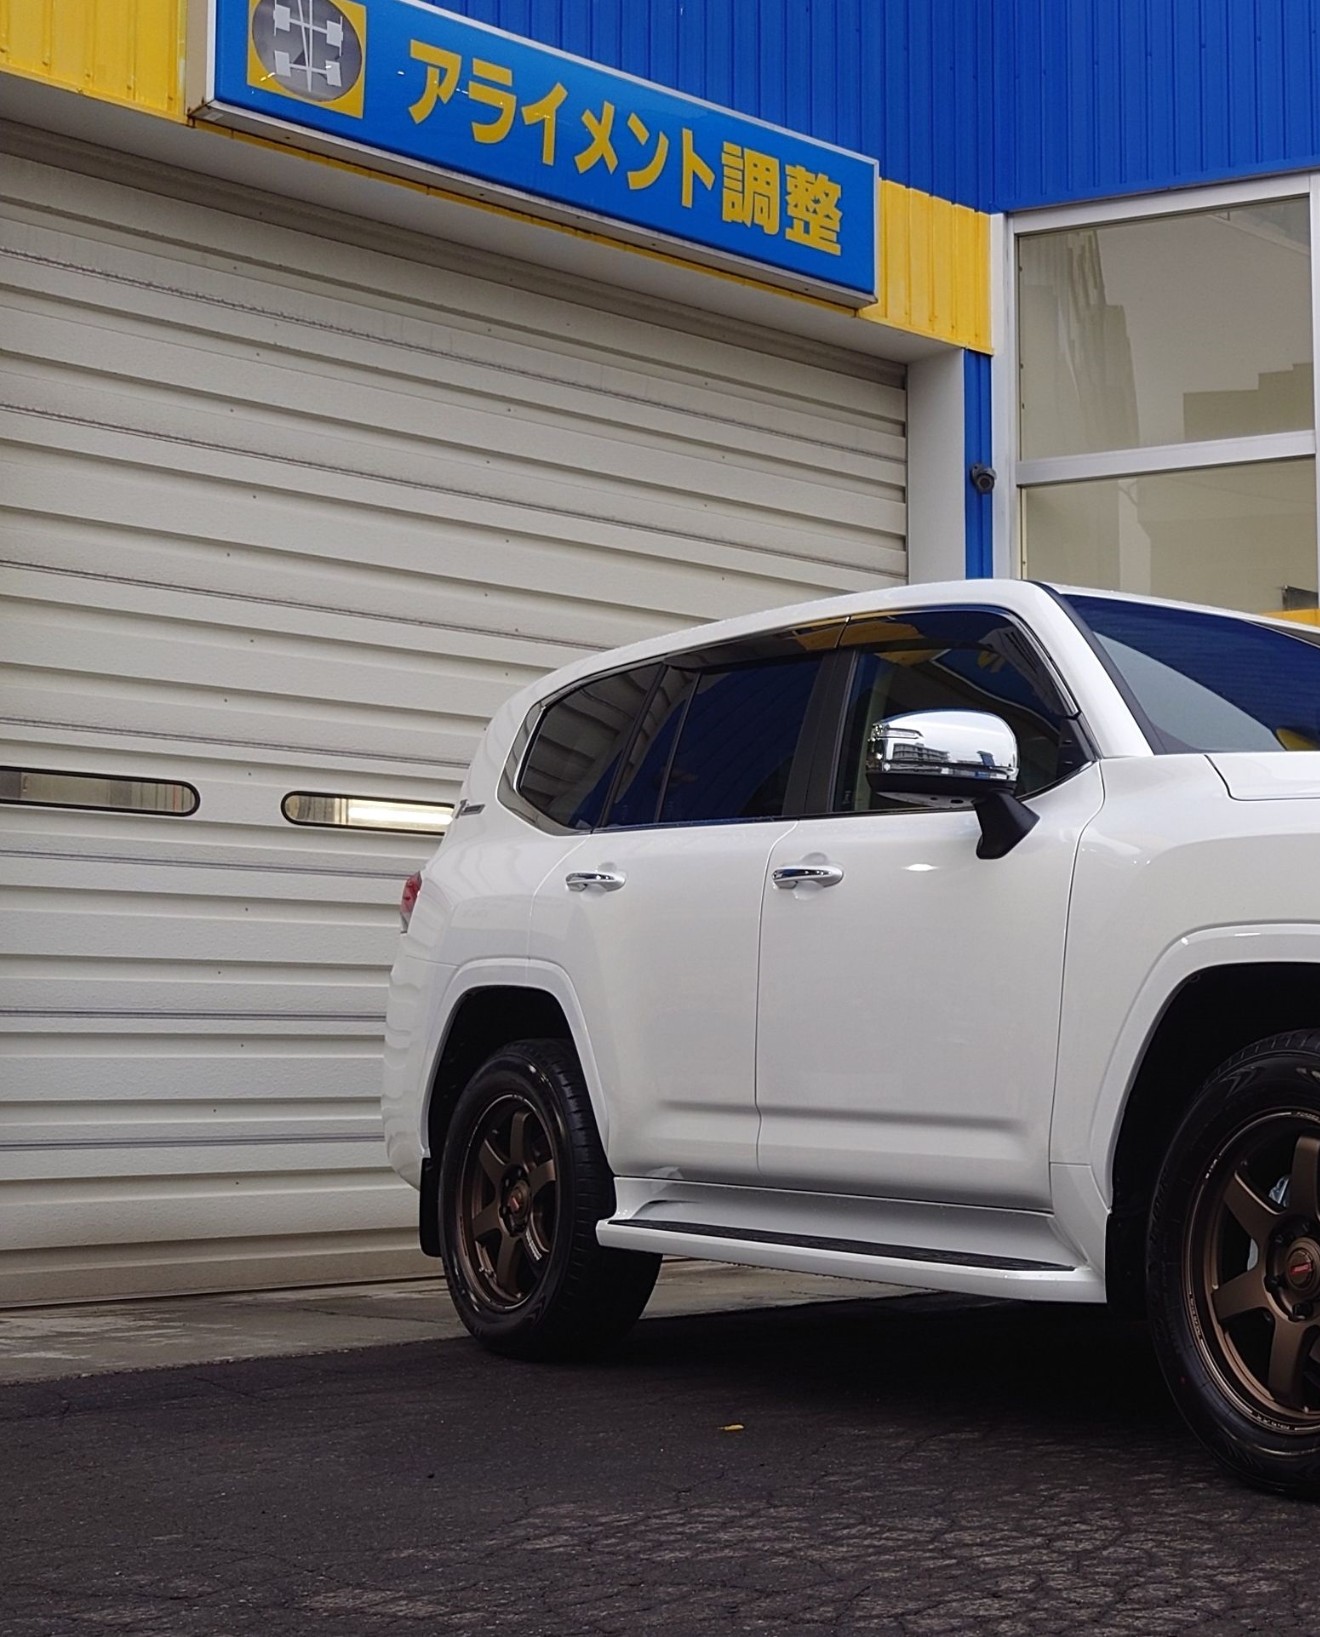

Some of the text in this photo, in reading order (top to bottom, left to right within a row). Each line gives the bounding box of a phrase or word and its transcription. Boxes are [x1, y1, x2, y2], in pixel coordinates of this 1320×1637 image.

[409, 39, 842, 256] アライメント調整
